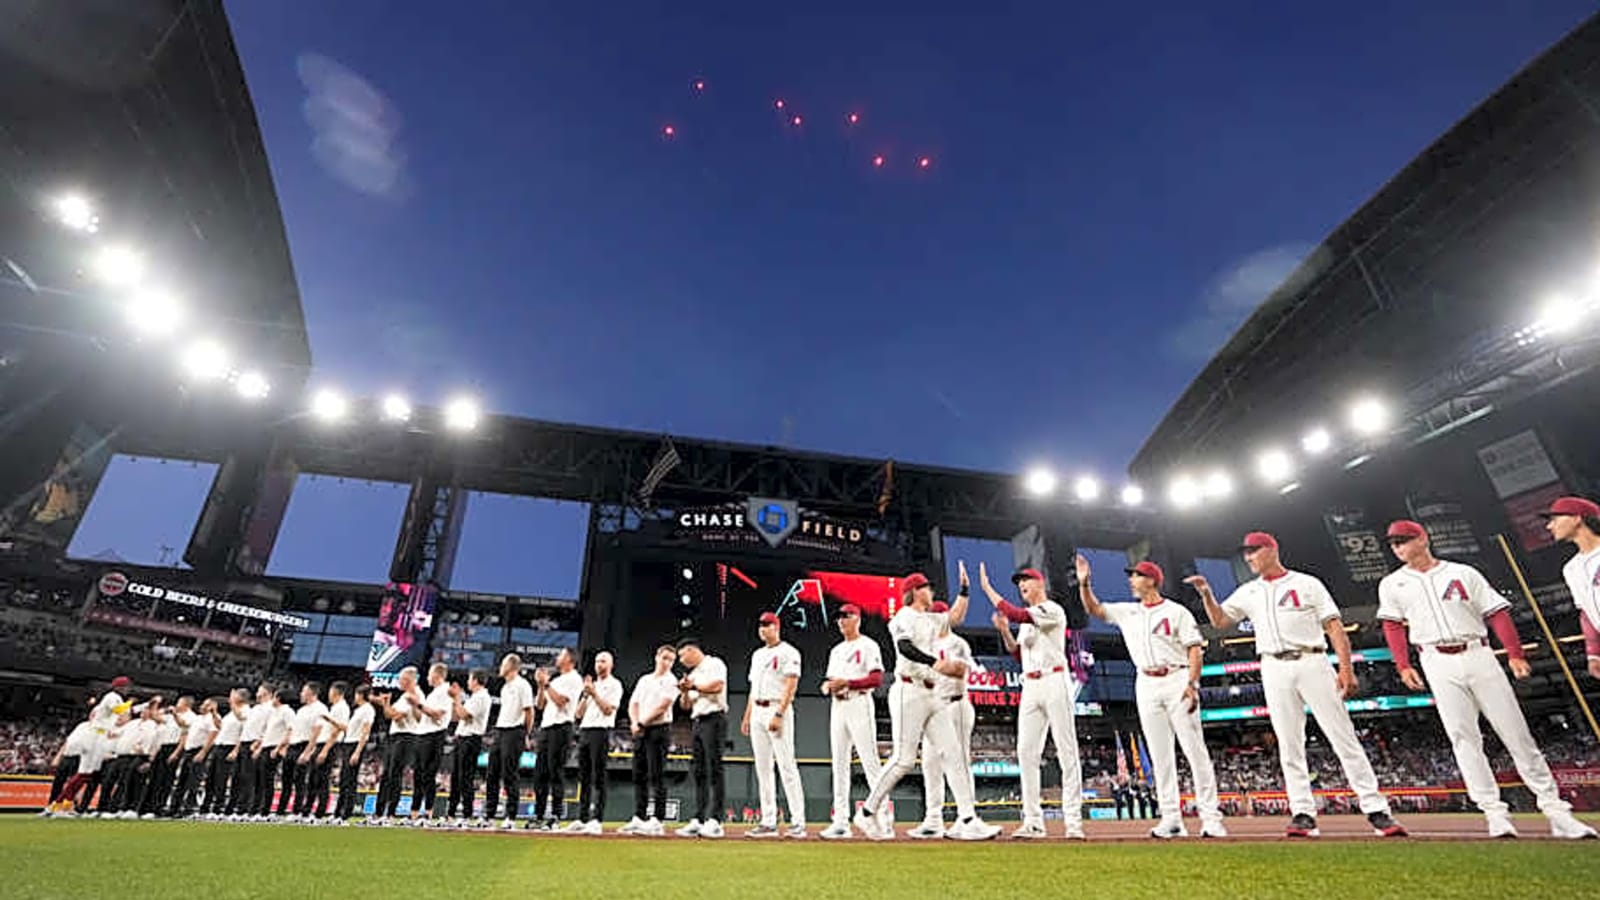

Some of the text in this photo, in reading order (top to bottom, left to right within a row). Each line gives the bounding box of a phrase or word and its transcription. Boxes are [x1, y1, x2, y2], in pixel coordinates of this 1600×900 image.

[680, 513, 862, 542] CHASE FIELD
[128, 582, 164, 599] COLD
[165, 589, 207, 607] BEERS
[216, 600, 310, 629] CHEESEBURGERS
